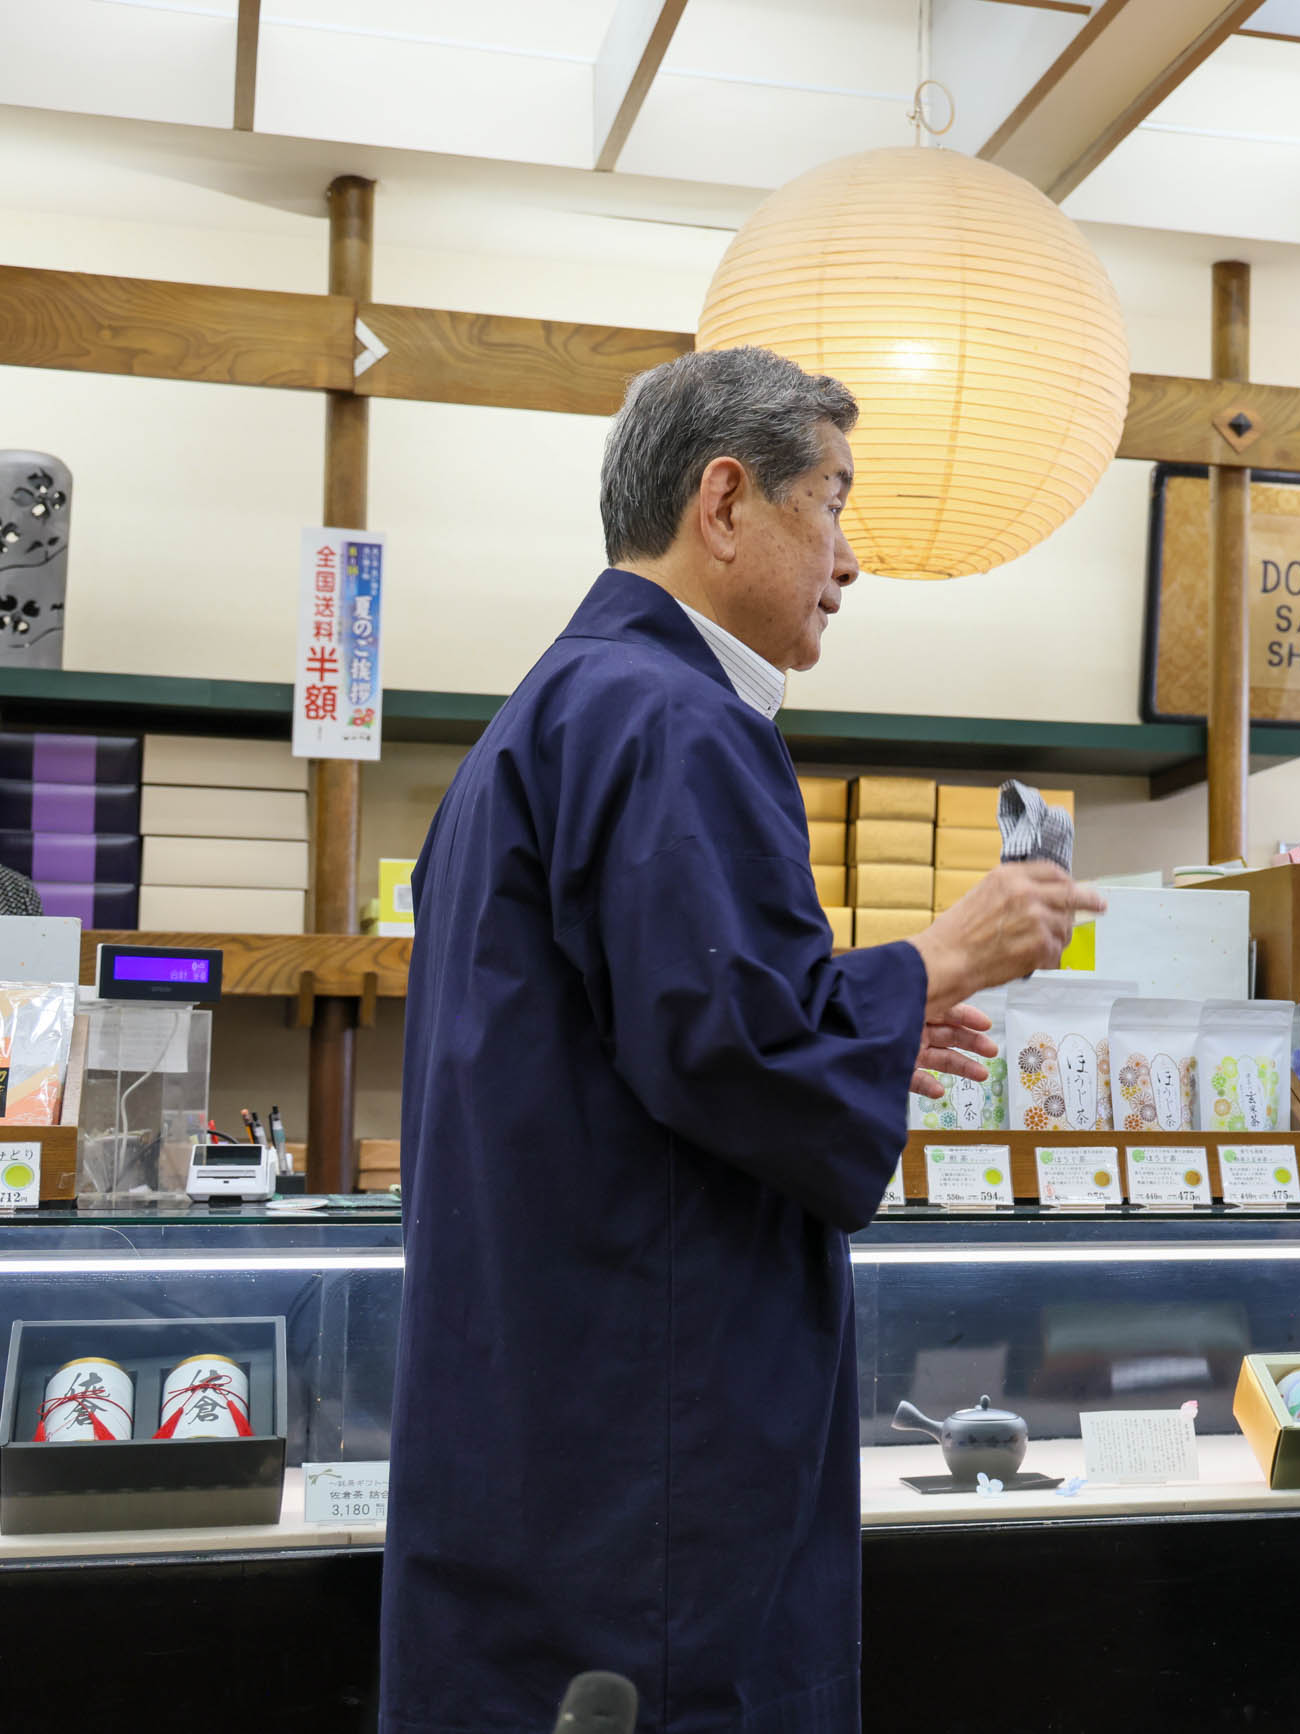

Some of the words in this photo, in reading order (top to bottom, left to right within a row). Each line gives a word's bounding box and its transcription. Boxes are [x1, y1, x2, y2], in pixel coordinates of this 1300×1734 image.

[1066, 1053, 1089, 1126] ほうじ茶
[1157, 1071, 1176, 1128] ほうじ茶
[332, 1503, 370, 1516] 3,180
